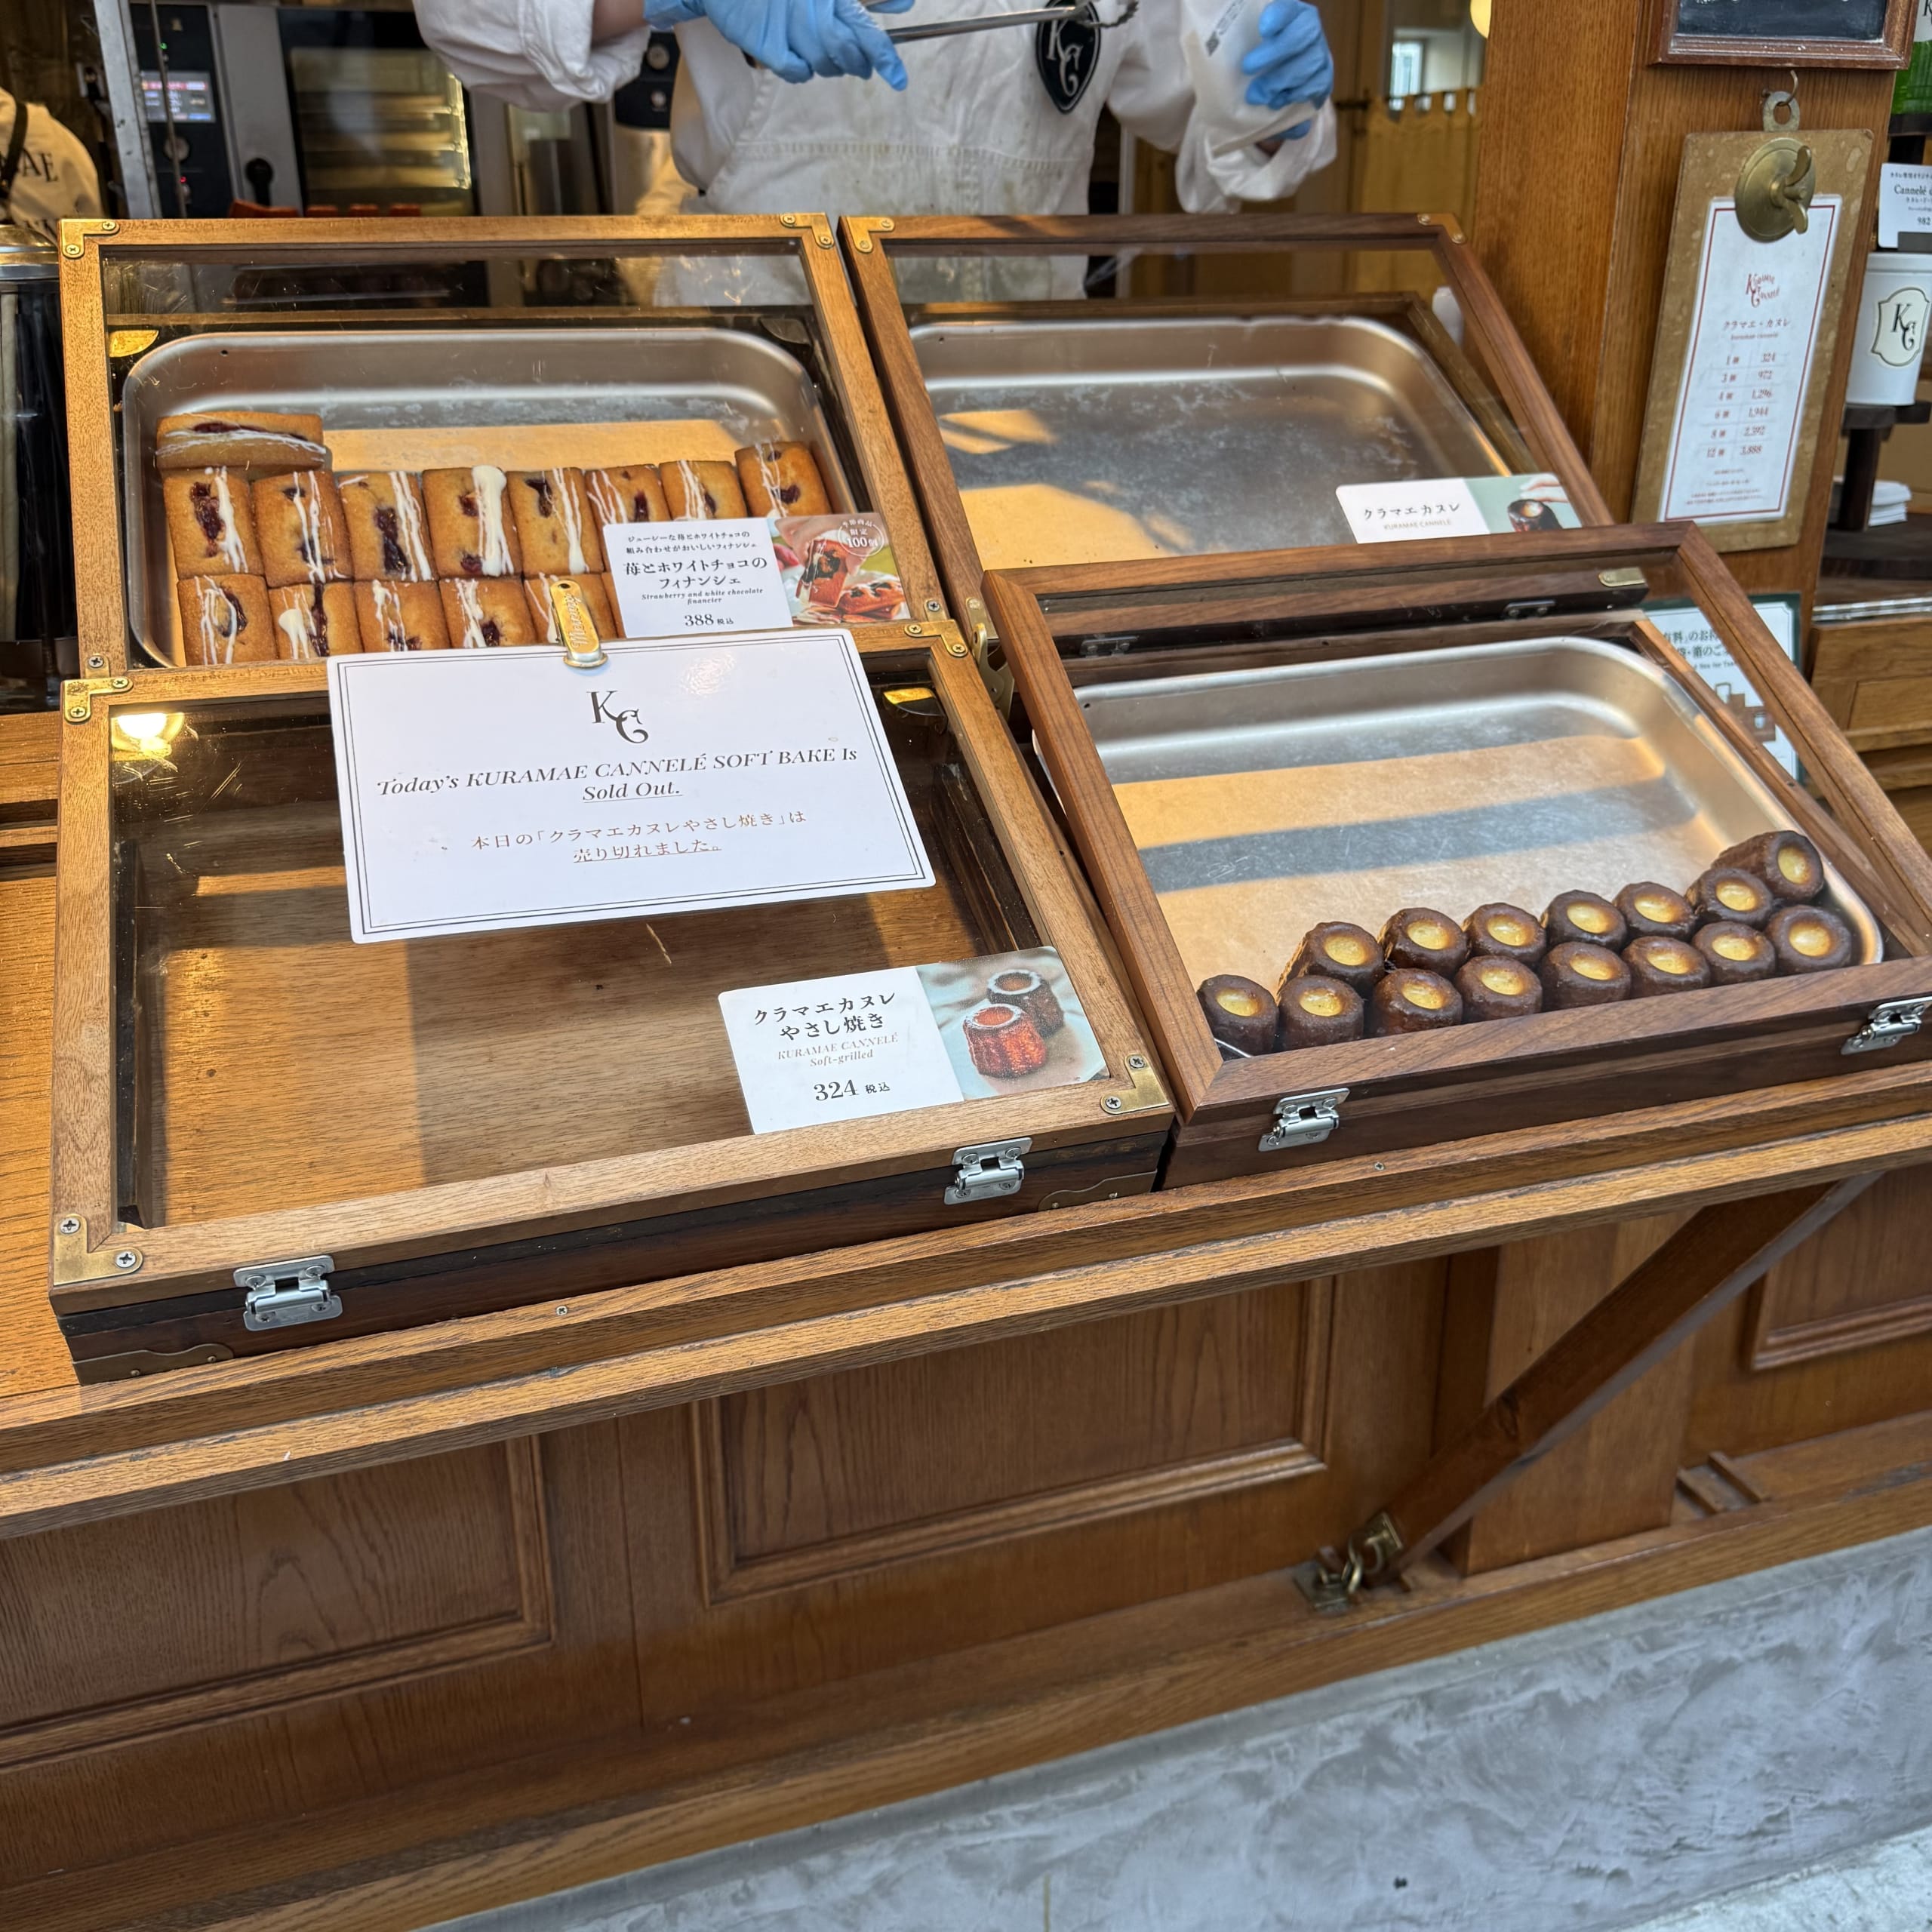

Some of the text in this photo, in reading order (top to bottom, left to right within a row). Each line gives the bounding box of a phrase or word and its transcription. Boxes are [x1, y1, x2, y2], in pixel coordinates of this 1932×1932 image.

[1917, 216, 1930, 226] 982
[1364, 503, 1460, 520] クラマエカヌレ
[626, 543, 757, 554] 組み合わせがおいしいフィナンシェ
[623, 557, 768, 576] 苺とホワイトチョコの
[659, 575, 741, 589] フィナンシェ
[641, 592, 685, 601] Strawberry
[728, 587, 764, 595] chocolate
[687, 597, 722, 605] financier
[685, 614, 715, 626] 388
[466, 765, 588, 787] KURAMAE
[595, 753, 707, 779] CANNELÉ
[713, 750, 774, 769] SOFT
[778, 748, 835, 765] BAKE
[841, 748, 857, 761] Is
[582, 781, 681, 801] Sold Out.
[472, 811, 807, 851] 本日の「クラマエカヌレやさし焼き」は
[574, 839, 720, 863] 売り切れました。
[755, 992, 895, 1026] クラマエカヌレ
[780, 1013, 884, 1041] やさし焼き
[778, 1032, 899, 1060] KURAMAE CANNELÉ
[809, 1049, 874, 1066] Soft-grilled
[814, 1079, 891, 1101] 324 税込
